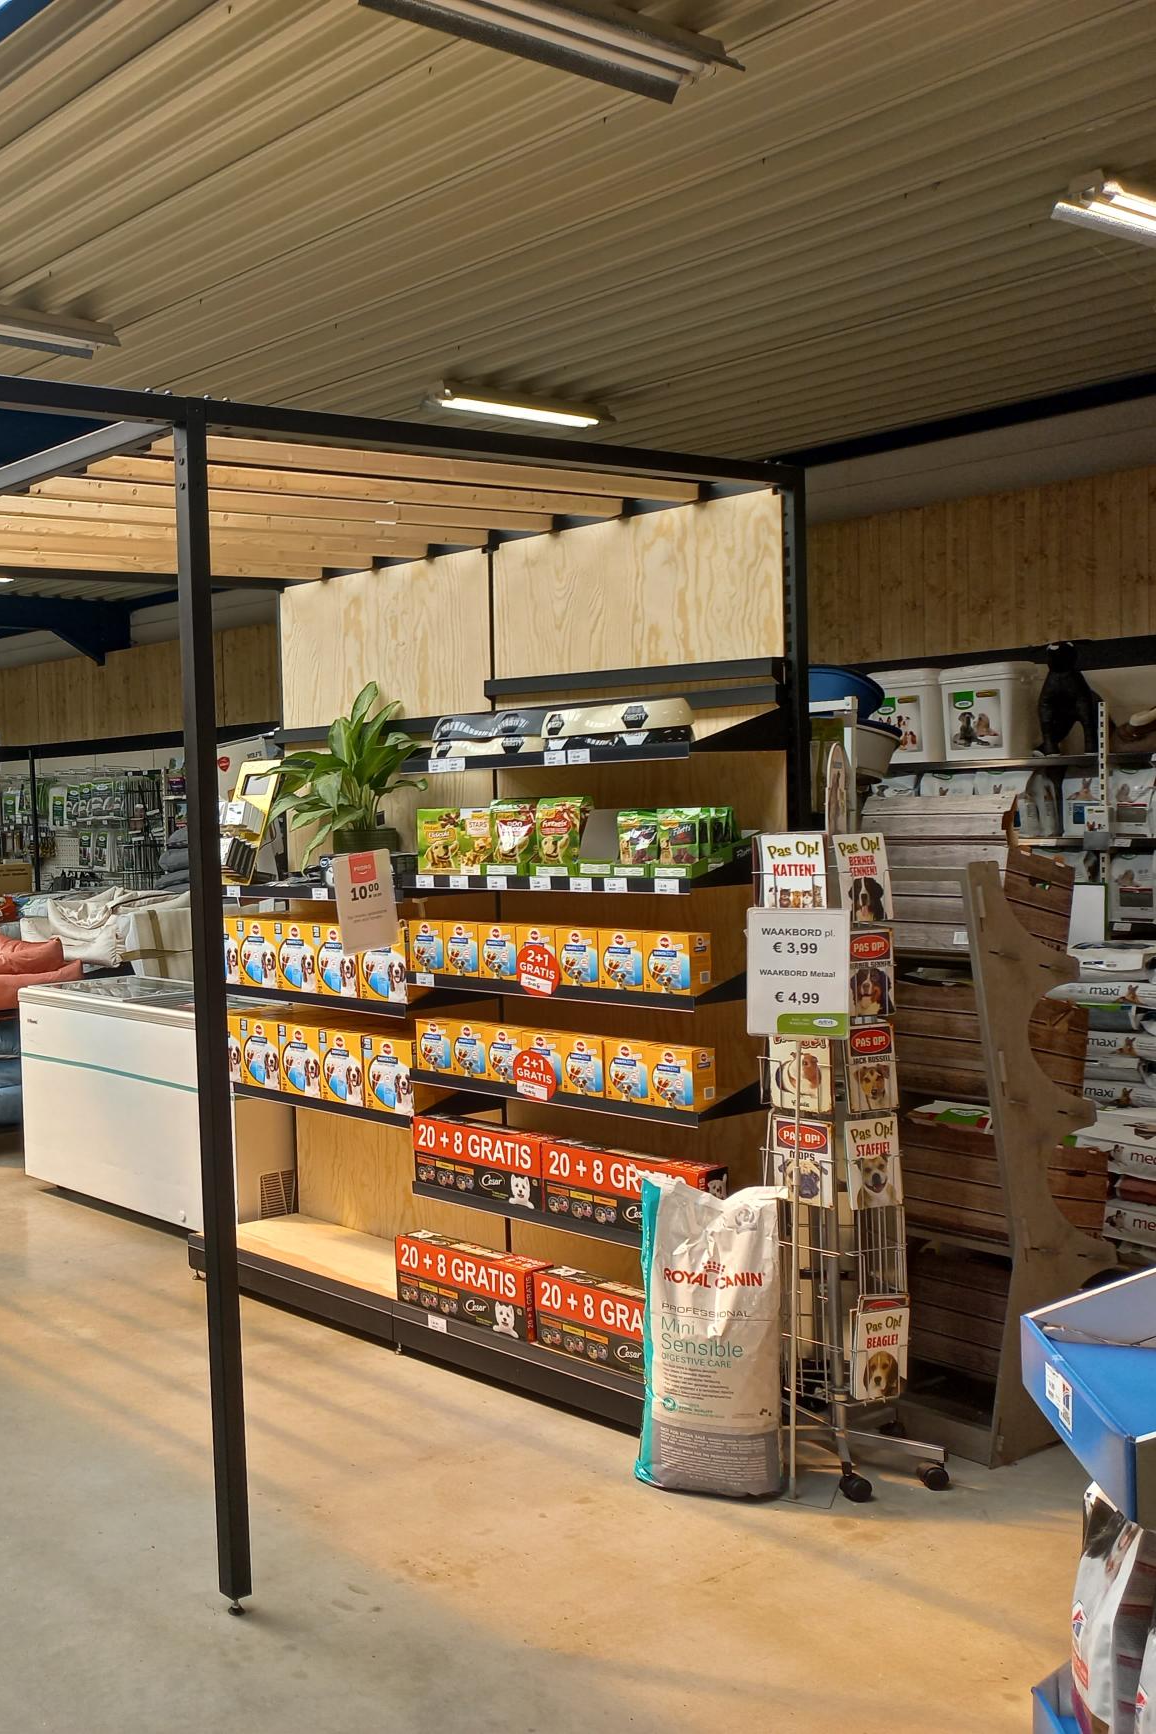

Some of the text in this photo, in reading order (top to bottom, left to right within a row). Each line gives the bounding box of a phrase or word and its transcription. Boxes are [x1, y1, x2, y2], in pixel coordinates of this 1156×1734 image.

[768, 841, 819, 859] Pas Op!
[838, 836, 880, 856] Pas Op!
[848, 855, 875, 866] BERNER
[773, 864, 816, 877] KATTEN!
[761, 928, 836, 938] WAAKBORD pl.
[772, 942, 818, 955] € 3,99
[853, 942, 869, 952] PAS
[527, 950, 549, 966] 2+1
[520, 962, 555, 979] GRATIS
[760, 969, 808, 977] WAAKBORD
[775, 992, 820, 1005] € 4,99
[1090, 986, 1121, 996] maxi
[855, 1036, 886, 1047] PAS OP!
[523, 1056, 544, 1071] 2+1
[516, 1068, 552, 1084] GRATIS
[1084, 1086, 1115, 1098] maxi
[805, 1132, 821, 1144] OP!
[850, 1121, 893, 1143] Pas Op!
[418, 1124, 531, 1170] 20 + 8 GRATIS
[856, 1142, 890, 1156] STAFFIE!
[549, 1151, 569, 1177] 20
[576, 1161, 586, 1176] +
[593, 1160, 604, 1184] 8
[626, 1206, 642, 1219] Ces
[401, 1244, 517, 1298] 20 + 8 GRATIS
[664, 1268, 762, 1289] ROYAL CANIN
[465, 1300, 487, 1312] Cesar
[541, 1281, 644, 1336] 20 + 8 GRA
[662, 1302, 752, 1318] PROFESSIONAL
[661, 1316, 695, 1335] Mini
[866, 1315, 902, 1334] Pas Op!
[661, 1333, 743, 1358] Sensible
[866, 1334, 898, 1349] BEAGLE!
[661, 1352, 732, 1368] DIGESTIVE CARE
